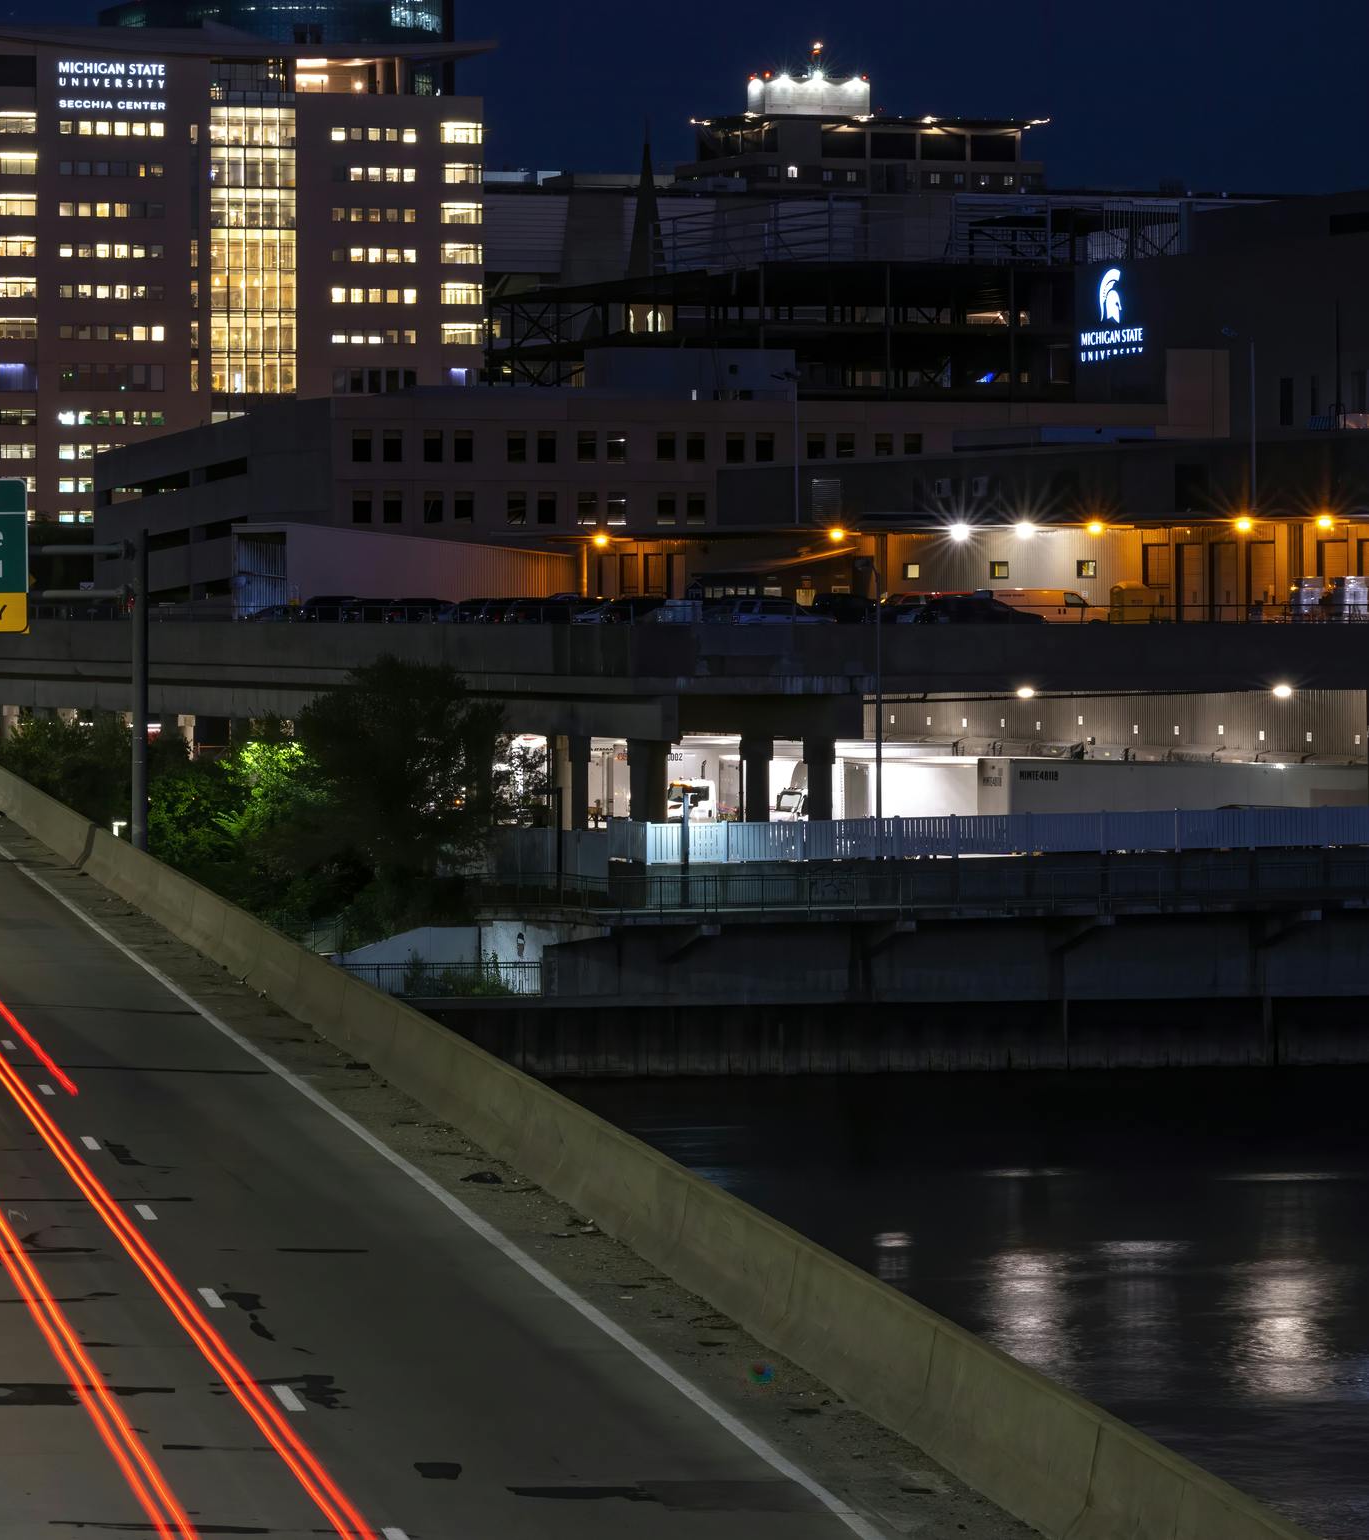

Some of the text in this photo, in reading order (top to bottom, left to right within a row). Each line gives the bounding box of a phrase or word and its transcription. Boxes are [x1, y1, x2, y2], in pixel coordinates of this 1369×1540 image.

[58, 62, 165, 76] MICHIGAN STATE
[58, 77, 165, 89] UNIVERSITY
[58, 99, 166, 110] SECCHIA CENTER
[1080, 327, 1143, 346] MICHIGAN STATE
